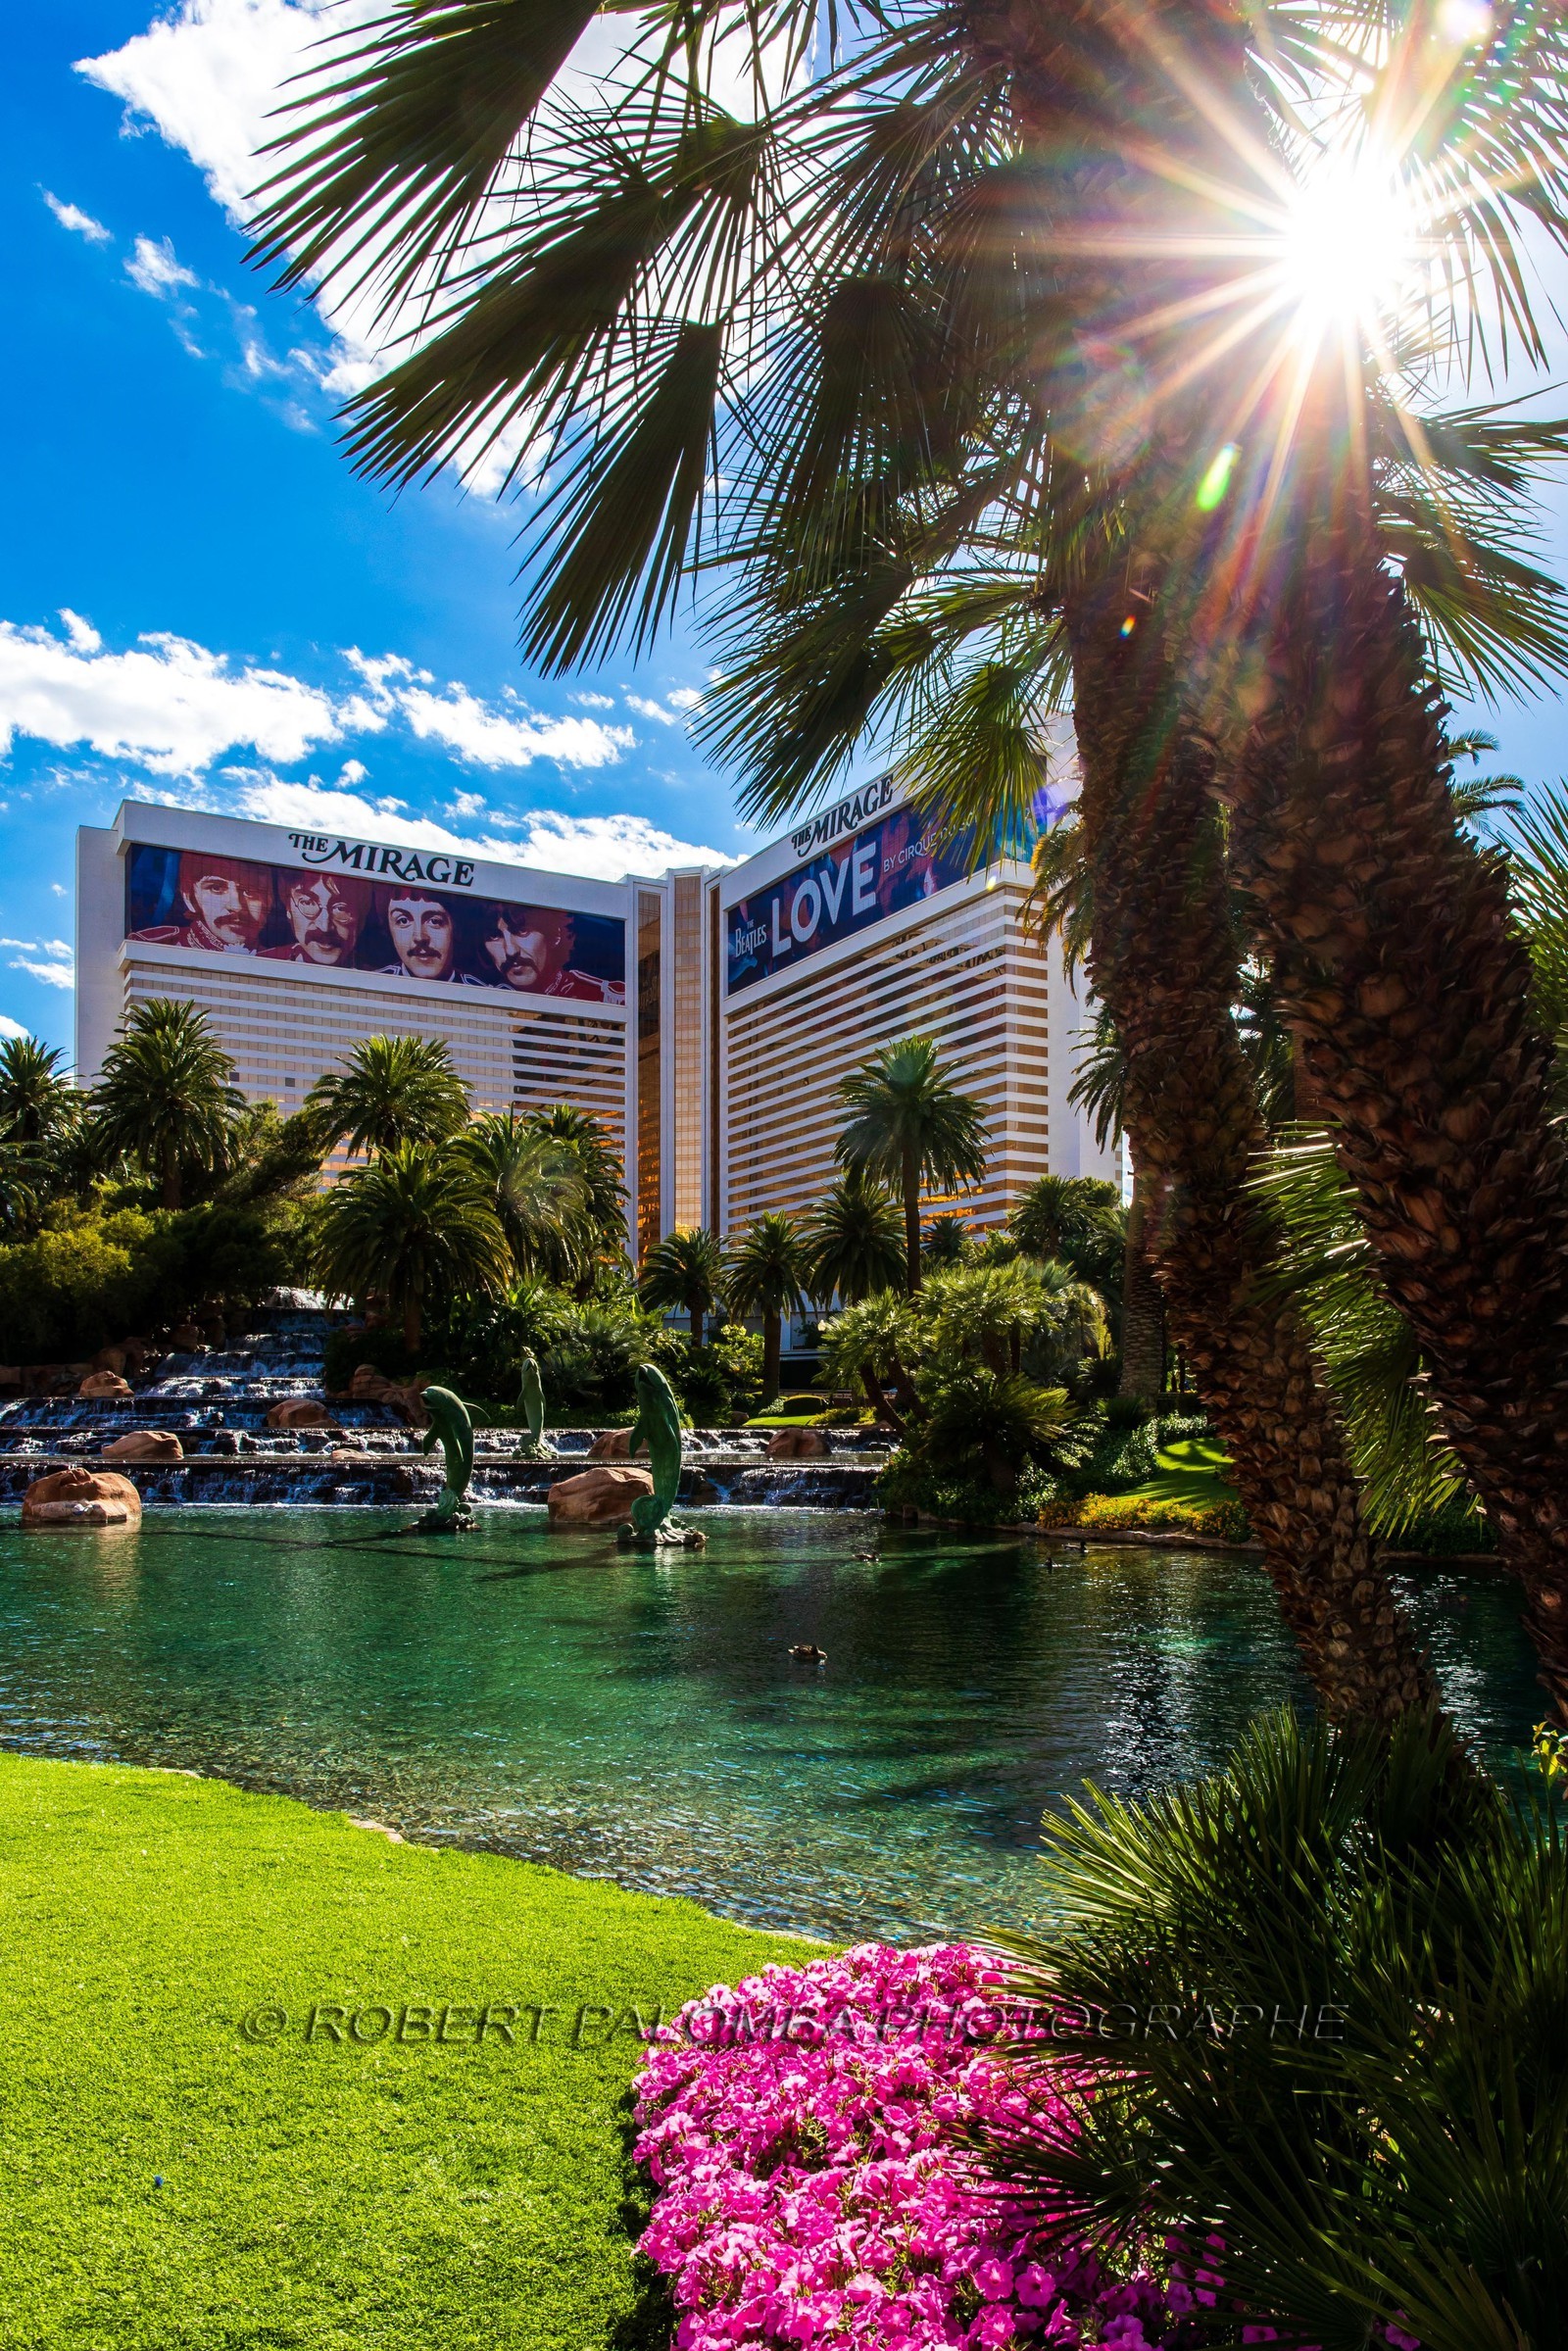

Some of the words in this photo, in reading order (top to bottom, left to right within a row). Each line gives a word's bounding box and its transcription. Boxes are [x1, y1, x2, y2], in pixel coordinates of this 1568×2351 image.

[797, 773, 894, 857] MIRAGE
[288, 833, 329, 853] THE
[791, 825, 811, 850] THE
[884, 857, 897, 873] BY
[899, 832, 938, 864] CIRQUE
[301, 840, 475, 887] MIRAGE
[772, 841, 876, 957] LOVE
[735, 924, 766, 957] BEATLES
